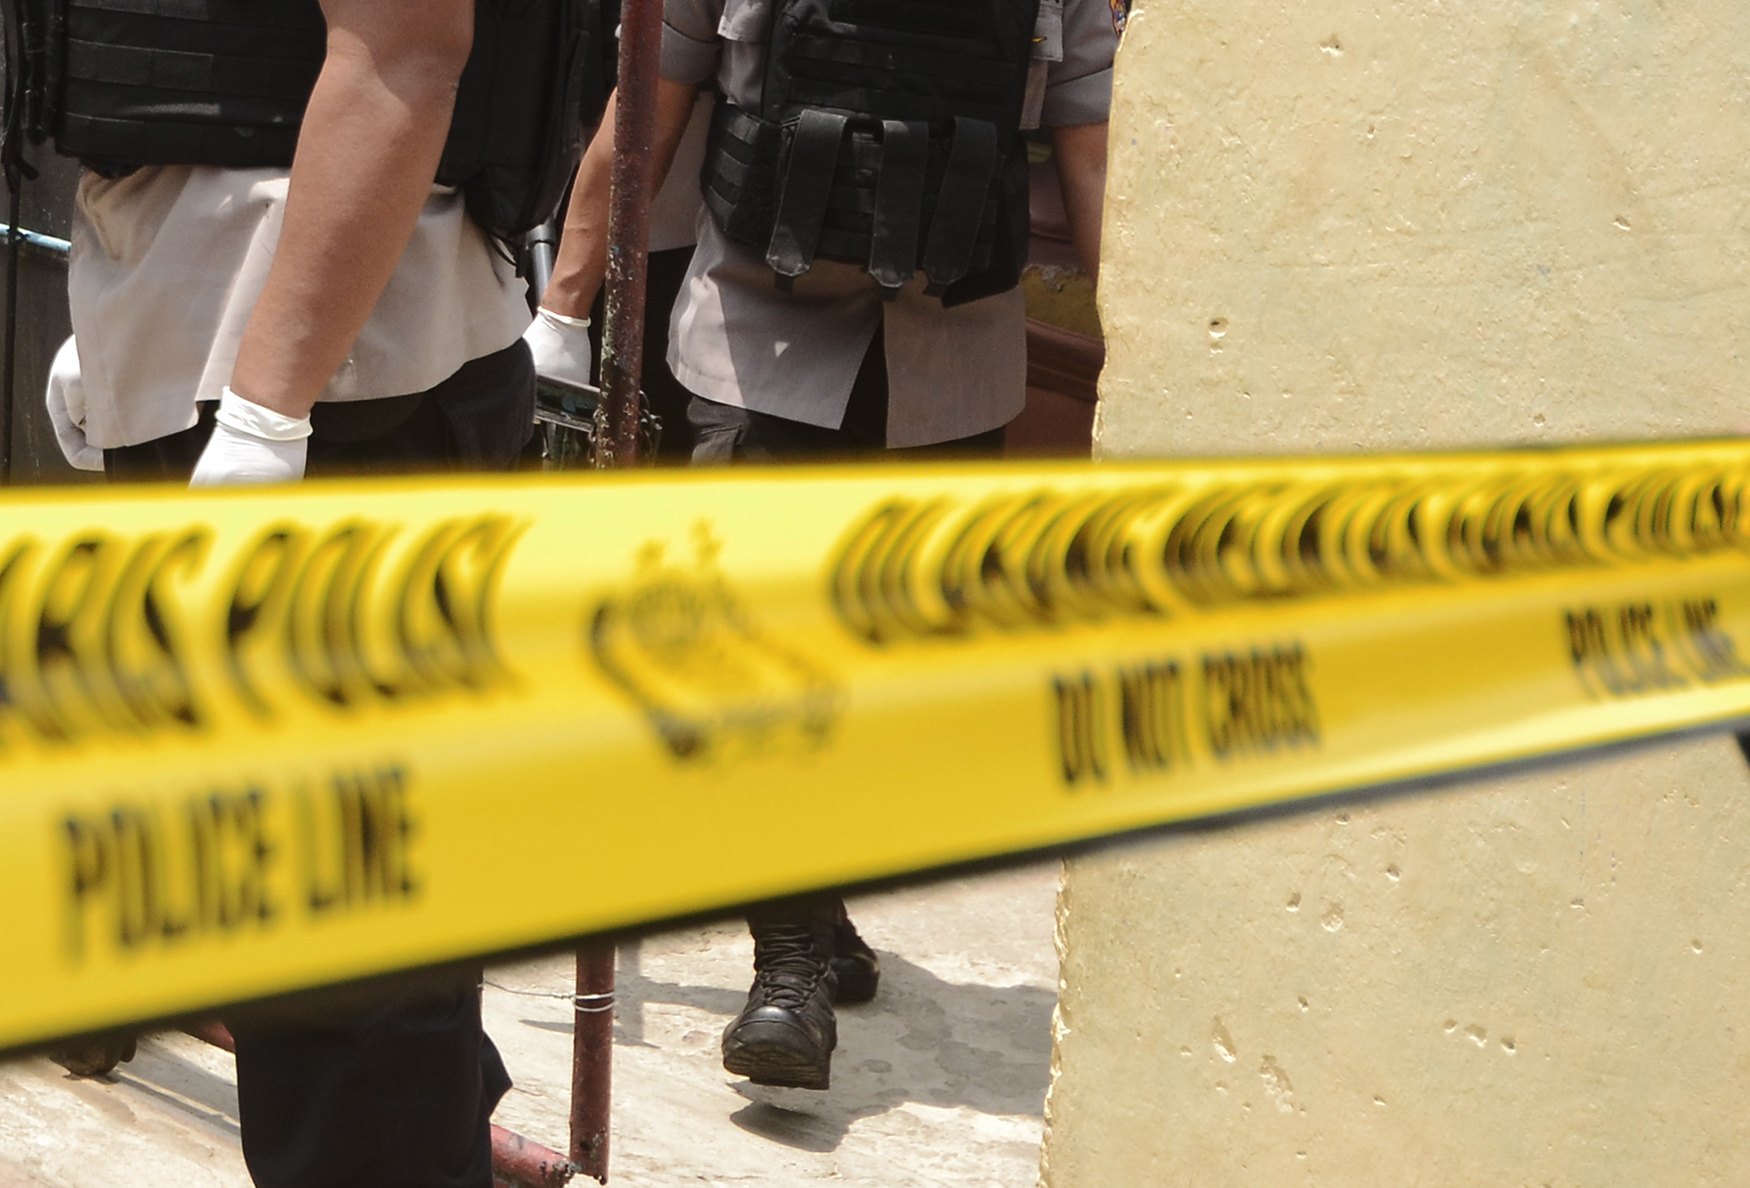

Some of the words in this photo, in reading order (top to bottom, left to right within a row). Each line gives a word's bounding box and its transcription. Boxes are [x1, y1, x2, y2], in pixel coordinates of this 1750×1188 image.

[224, 514, 530, 720] POLISI
[1050, 672, 1106, 786] DO
[1116, 658, 1190, 770] NOT
[1200, 640, 1322, 760] CROSS
[60, 777, 282, 964] POLICE
[304, 762, 422, 920] LINE
